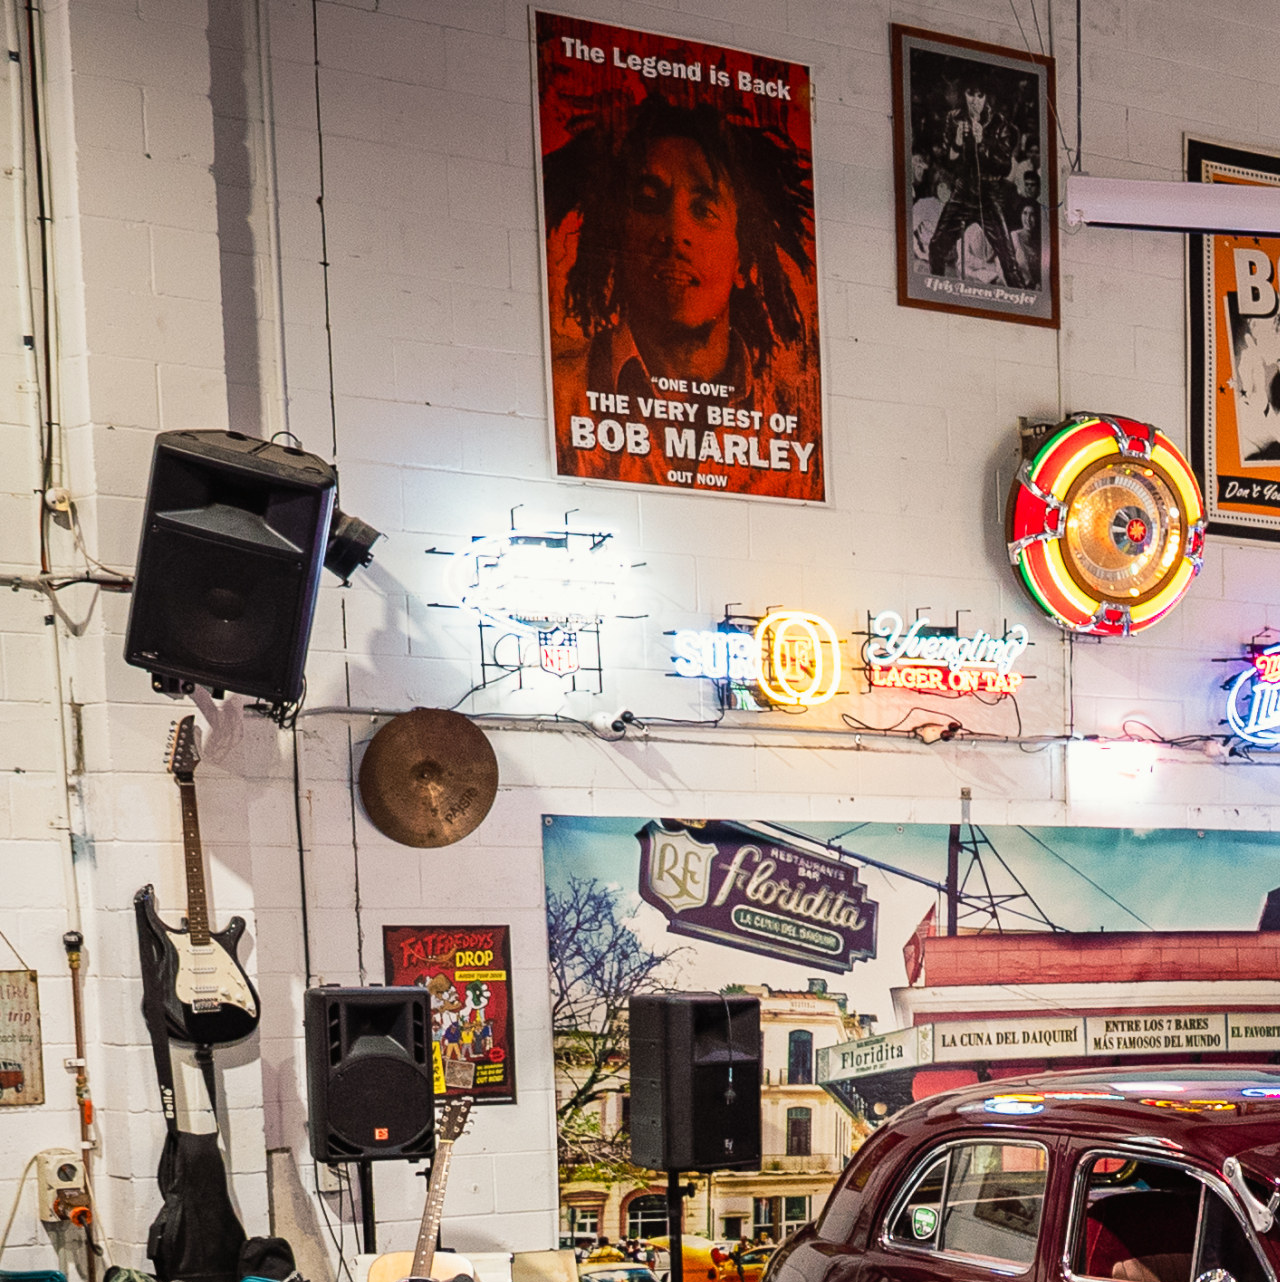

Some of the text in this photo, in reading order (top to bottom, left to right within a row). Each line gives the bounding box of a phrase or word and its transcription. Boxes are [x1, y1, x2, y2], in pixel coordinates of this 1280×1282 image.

[561, 36, 792, 101] The Legend is Back
[586, 390, 799, 435] THE VERY BEST OF
[569, 415, 815, 473] BOB MARLEY
[666, 469, 729, 488] OUT NOW
[1224, 480, 1262, 499] Don't
[867, 609, 1030, 673] Yuengling
[543, 648, 576, 672] NFL
[870, 663, 1024, 694] LAGER ON TAP
[711, 844, 868, 932] Floridita
[455, 949, 494, 968] DROP
[941, 1025, 1078, 1048] LA CUNA DEL DAIQUIRÍ
[1104, 1017, 1210, 1033] ENTRE LOS 7 BARES
[1230, 1025, 1243, 1039] EL
[1092, 1033, 1222, 1051] MÁS FAMOSOS DEL MUNDO
[841, 1043, 905, 1070] Floridita
